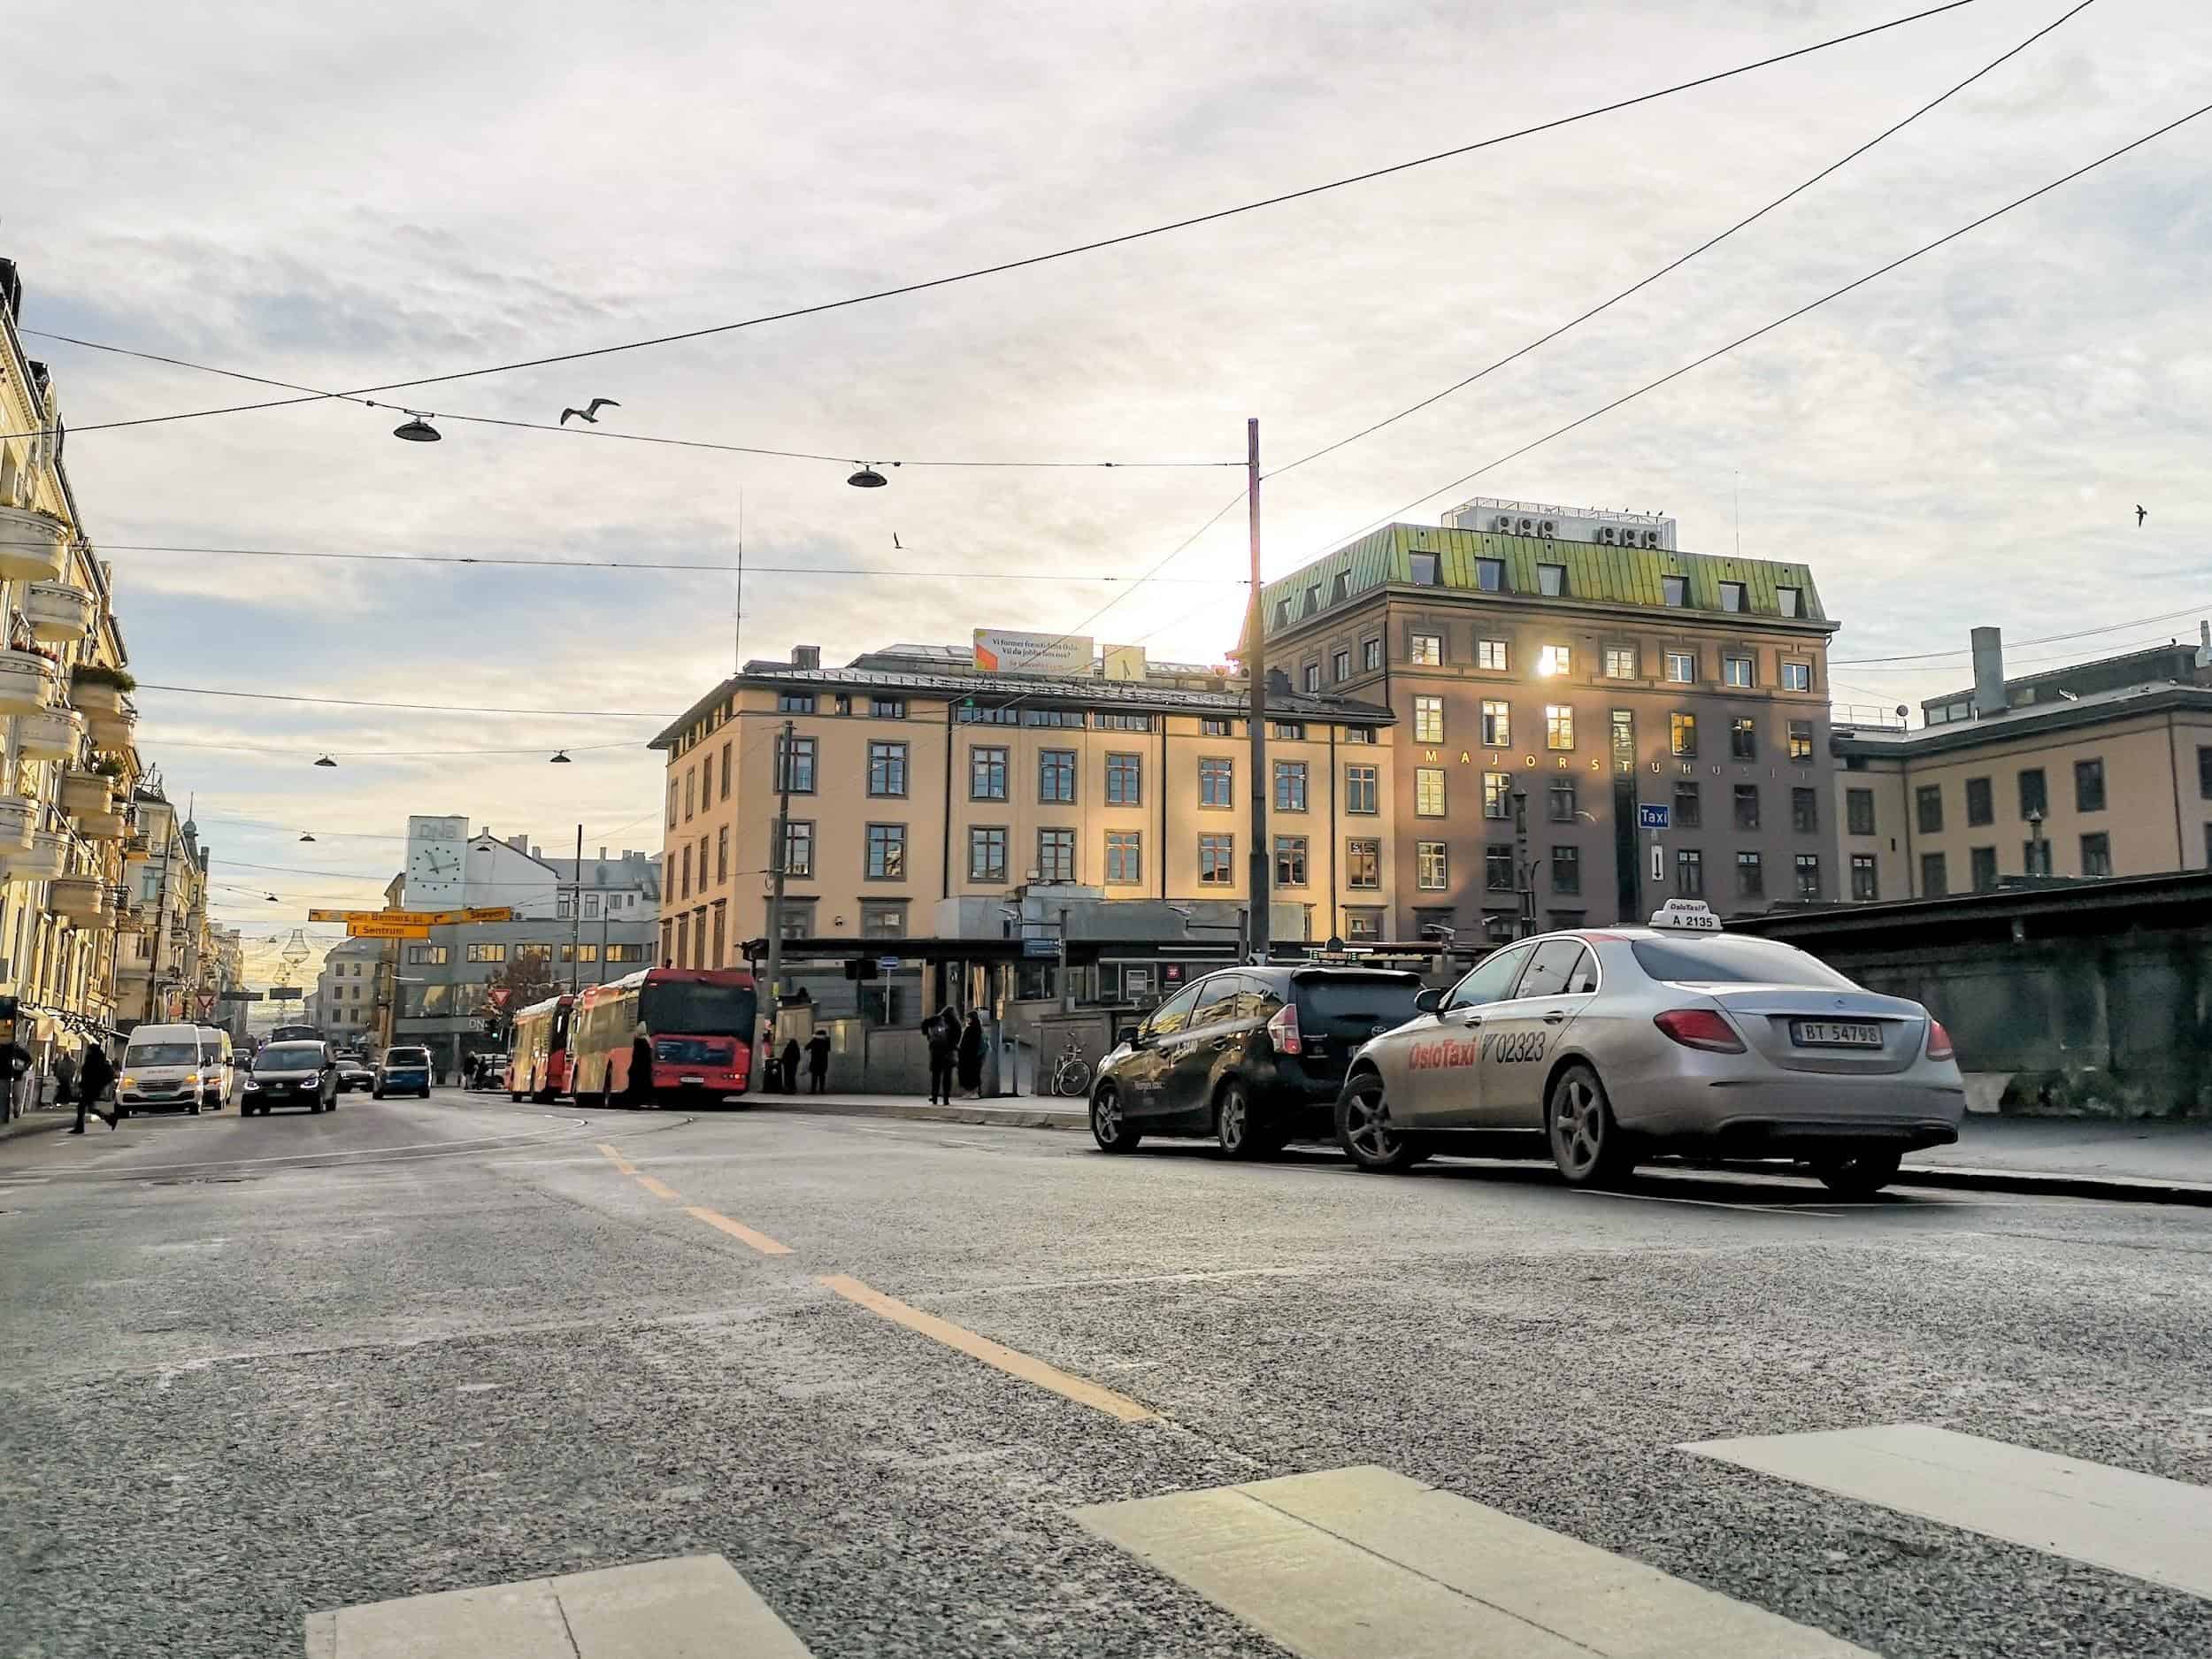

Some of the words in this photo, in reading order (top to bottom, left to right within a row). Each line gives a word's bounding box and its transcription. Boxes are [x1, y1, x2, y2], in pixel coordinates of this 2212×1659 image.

[1641, 809, 1667, 824] Taxi
[1673, 915, 1681, 926] A
[1686, 916, 1713, 928] 2135
[363, 926, 404, 936] Sentrum
[1804, 1025, 1824, 1041] BT
[1832, 1025, 1878, 1042] 54798
[1409, 1036, 1477, 1070] OsloTaxi
[1496, 1032, 1547, 1064] 02323
